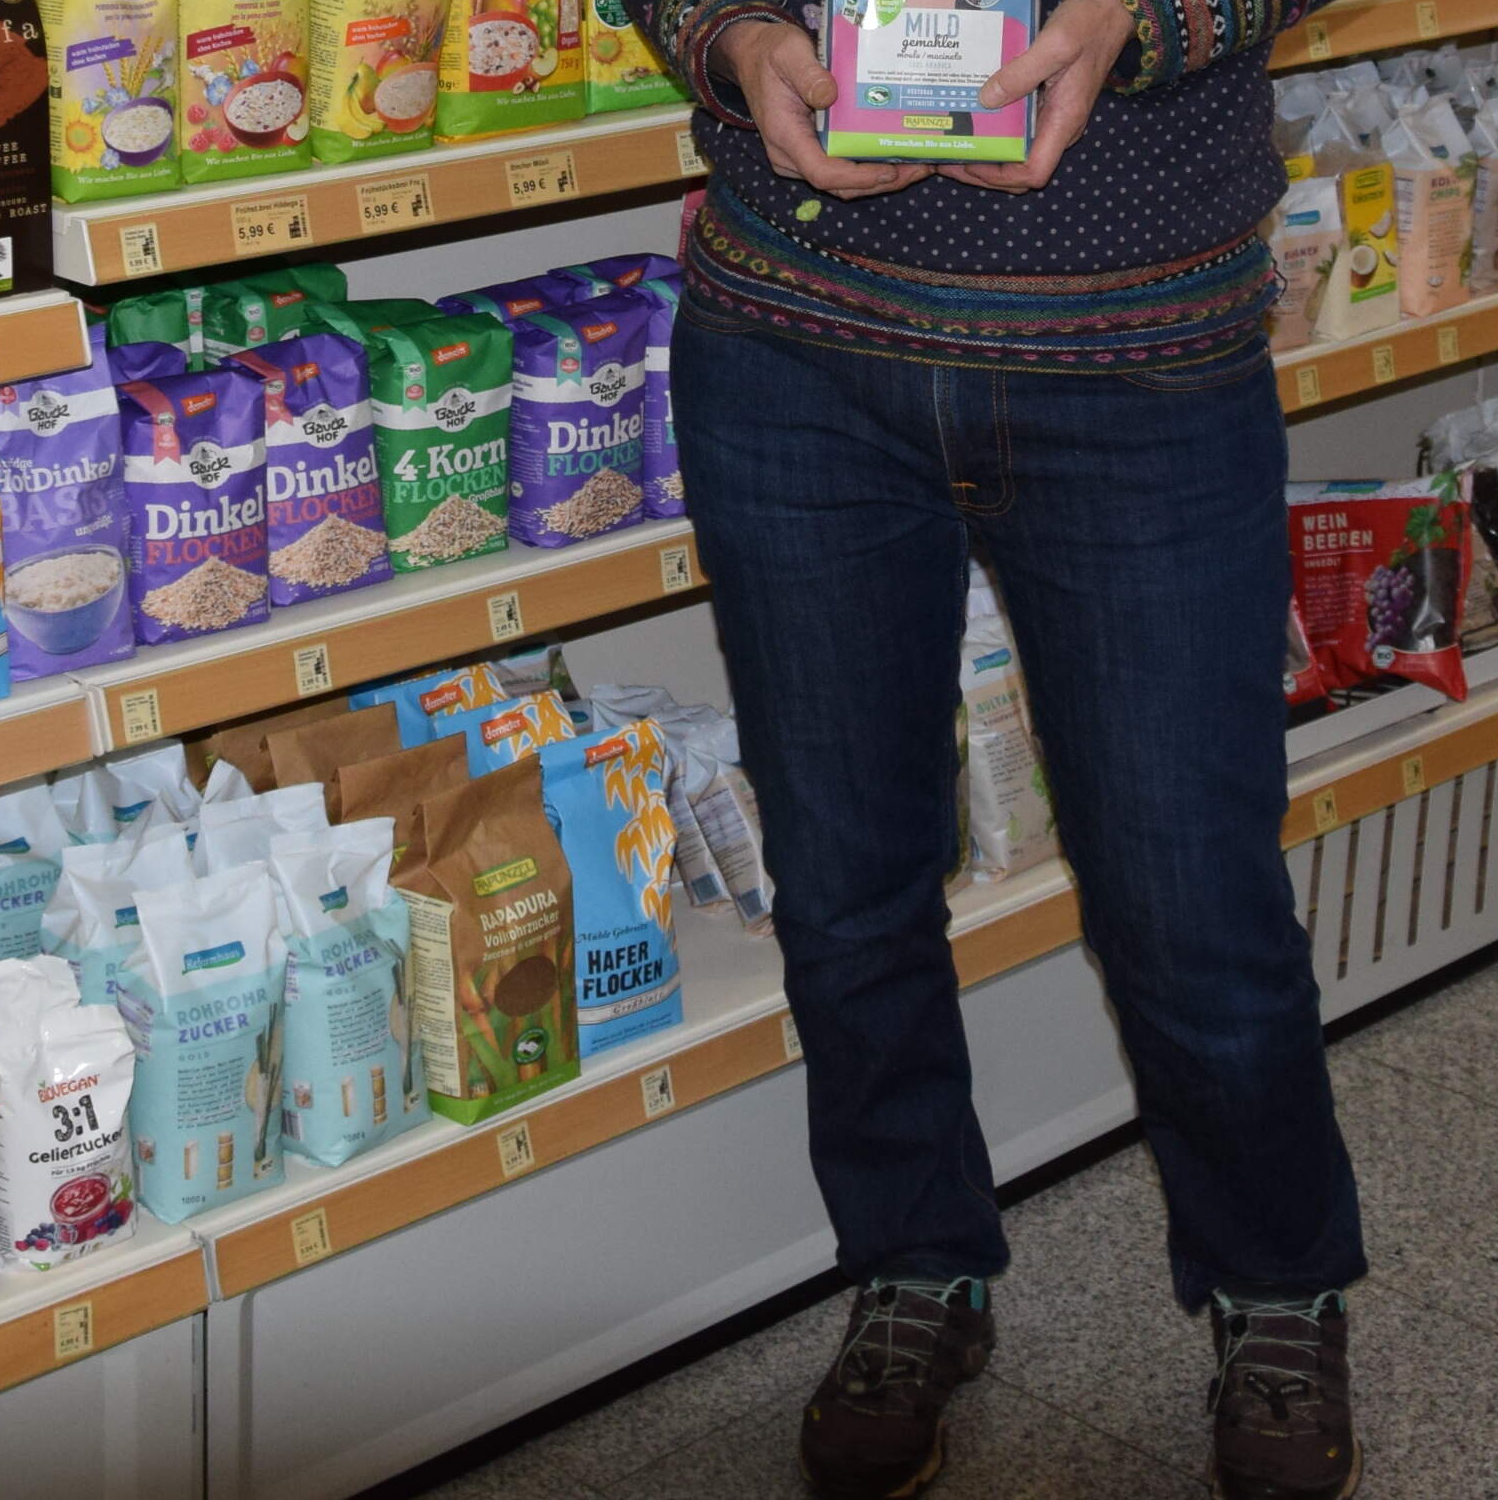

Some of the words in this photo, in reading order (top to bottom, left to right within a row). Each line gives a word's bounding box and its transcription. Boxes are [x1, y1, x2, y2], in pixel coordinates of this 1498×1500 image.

[906, 12, 959, 37] MILD
[205, 156, 220, 165] Wir
[224, 154, 250, 164] machen
[252, 153, 264, 161] Bio
[365, 203, 387, 218] 5,99
[391, 202, 399, 214] €
[238, 224, 263, 240] 5,99
[266, 223, 275, 235] €
[29, 407, 68, 423] Bauck
[37, 420, 59, 430] HOF
[393, 439, 506, 480] 4-Korn
[146, 488, 262, 540] Dinkel
[270, 485, 379, 524] FLOCKEN
[1303, 514, 1346, 531] WEIN
[147, 527, 263, 564] FLOCKEN
[1304, 531, 1373, 550] BEEREN
[475, 864, 535, 892] RAPUNZEL
[480, 891, 557, 931] RAPADURA
[485, 913, 559, 946] Vollrohrzucker
[179, 991, 266, 1024] ROHROHR
[179, 1014, 249, 1042] ZUCKER
[53, 1097, 99, 1142] 3:1
[29, 1130, 123, 1164] Gelierzucker
